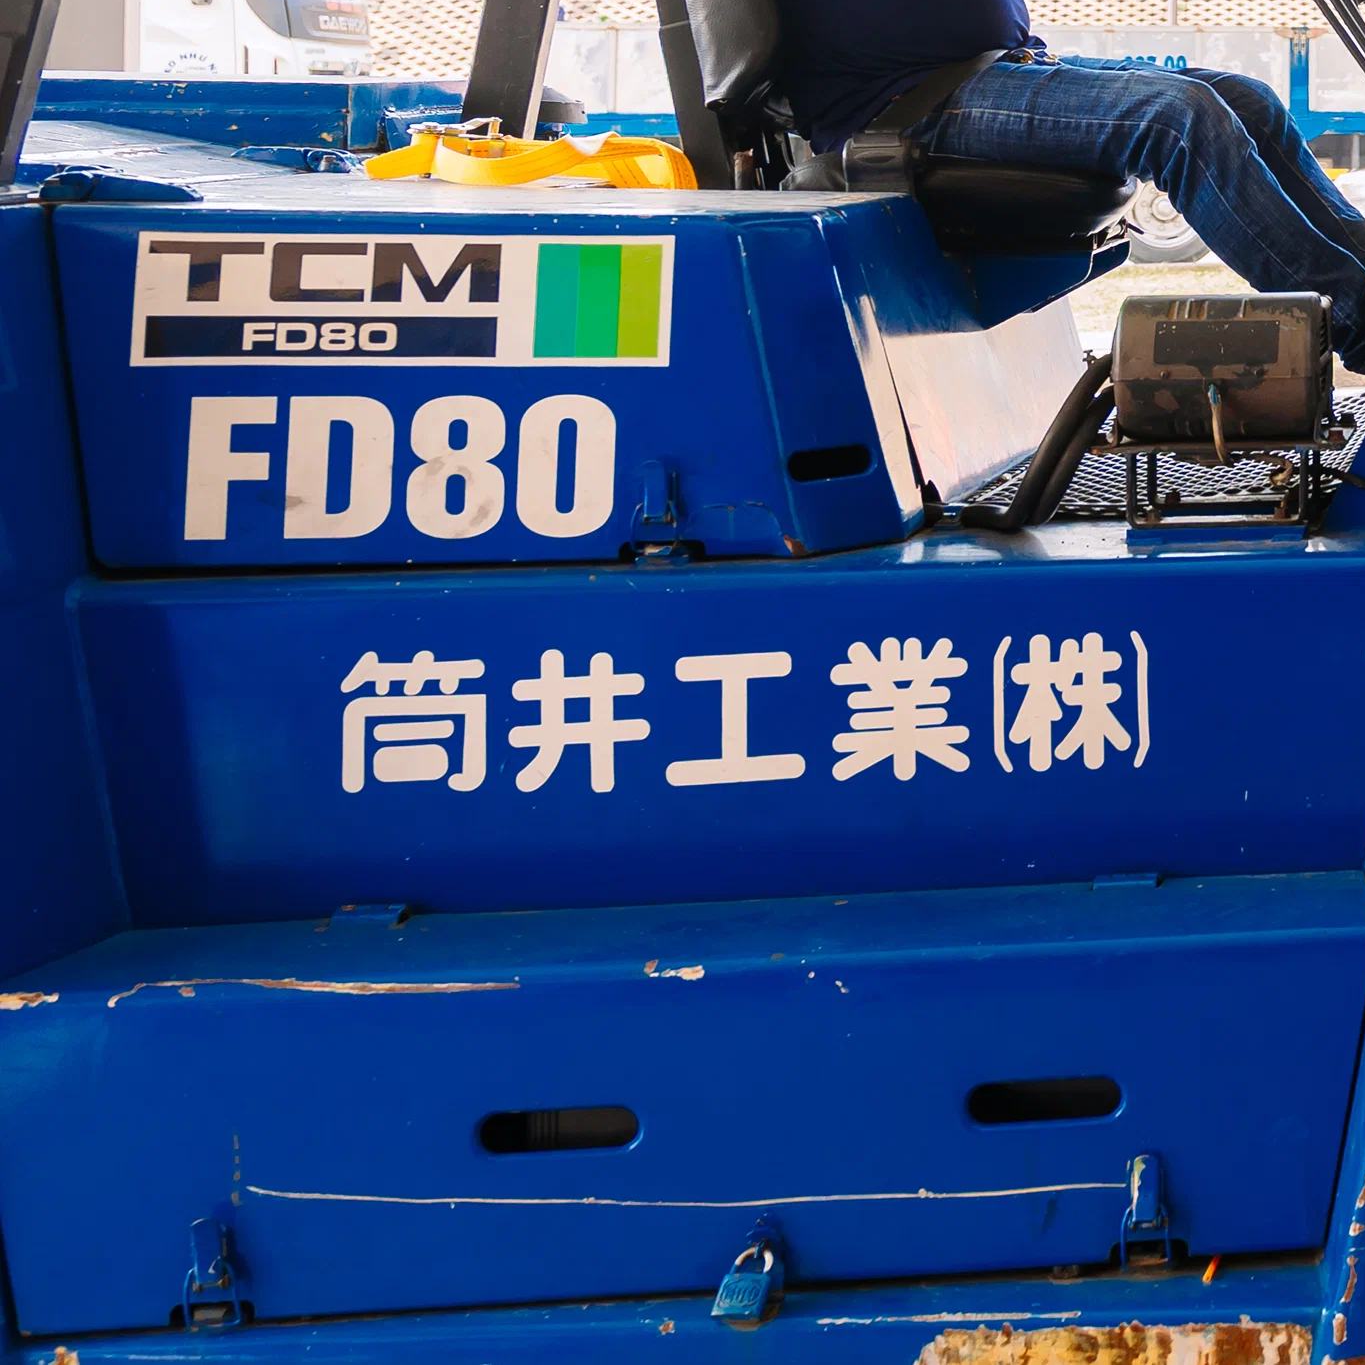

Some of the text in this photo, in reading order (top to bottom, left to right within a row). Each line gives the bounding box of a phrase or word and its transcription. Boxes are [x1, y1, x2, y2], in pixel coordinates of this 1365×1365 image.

[148, 240, 503, 303] TCM
[241, 321, 399, 353] FD80
[183, 394, 618, 541] FD80
[340, 629, 1150, 794] 筒井工業(株)
